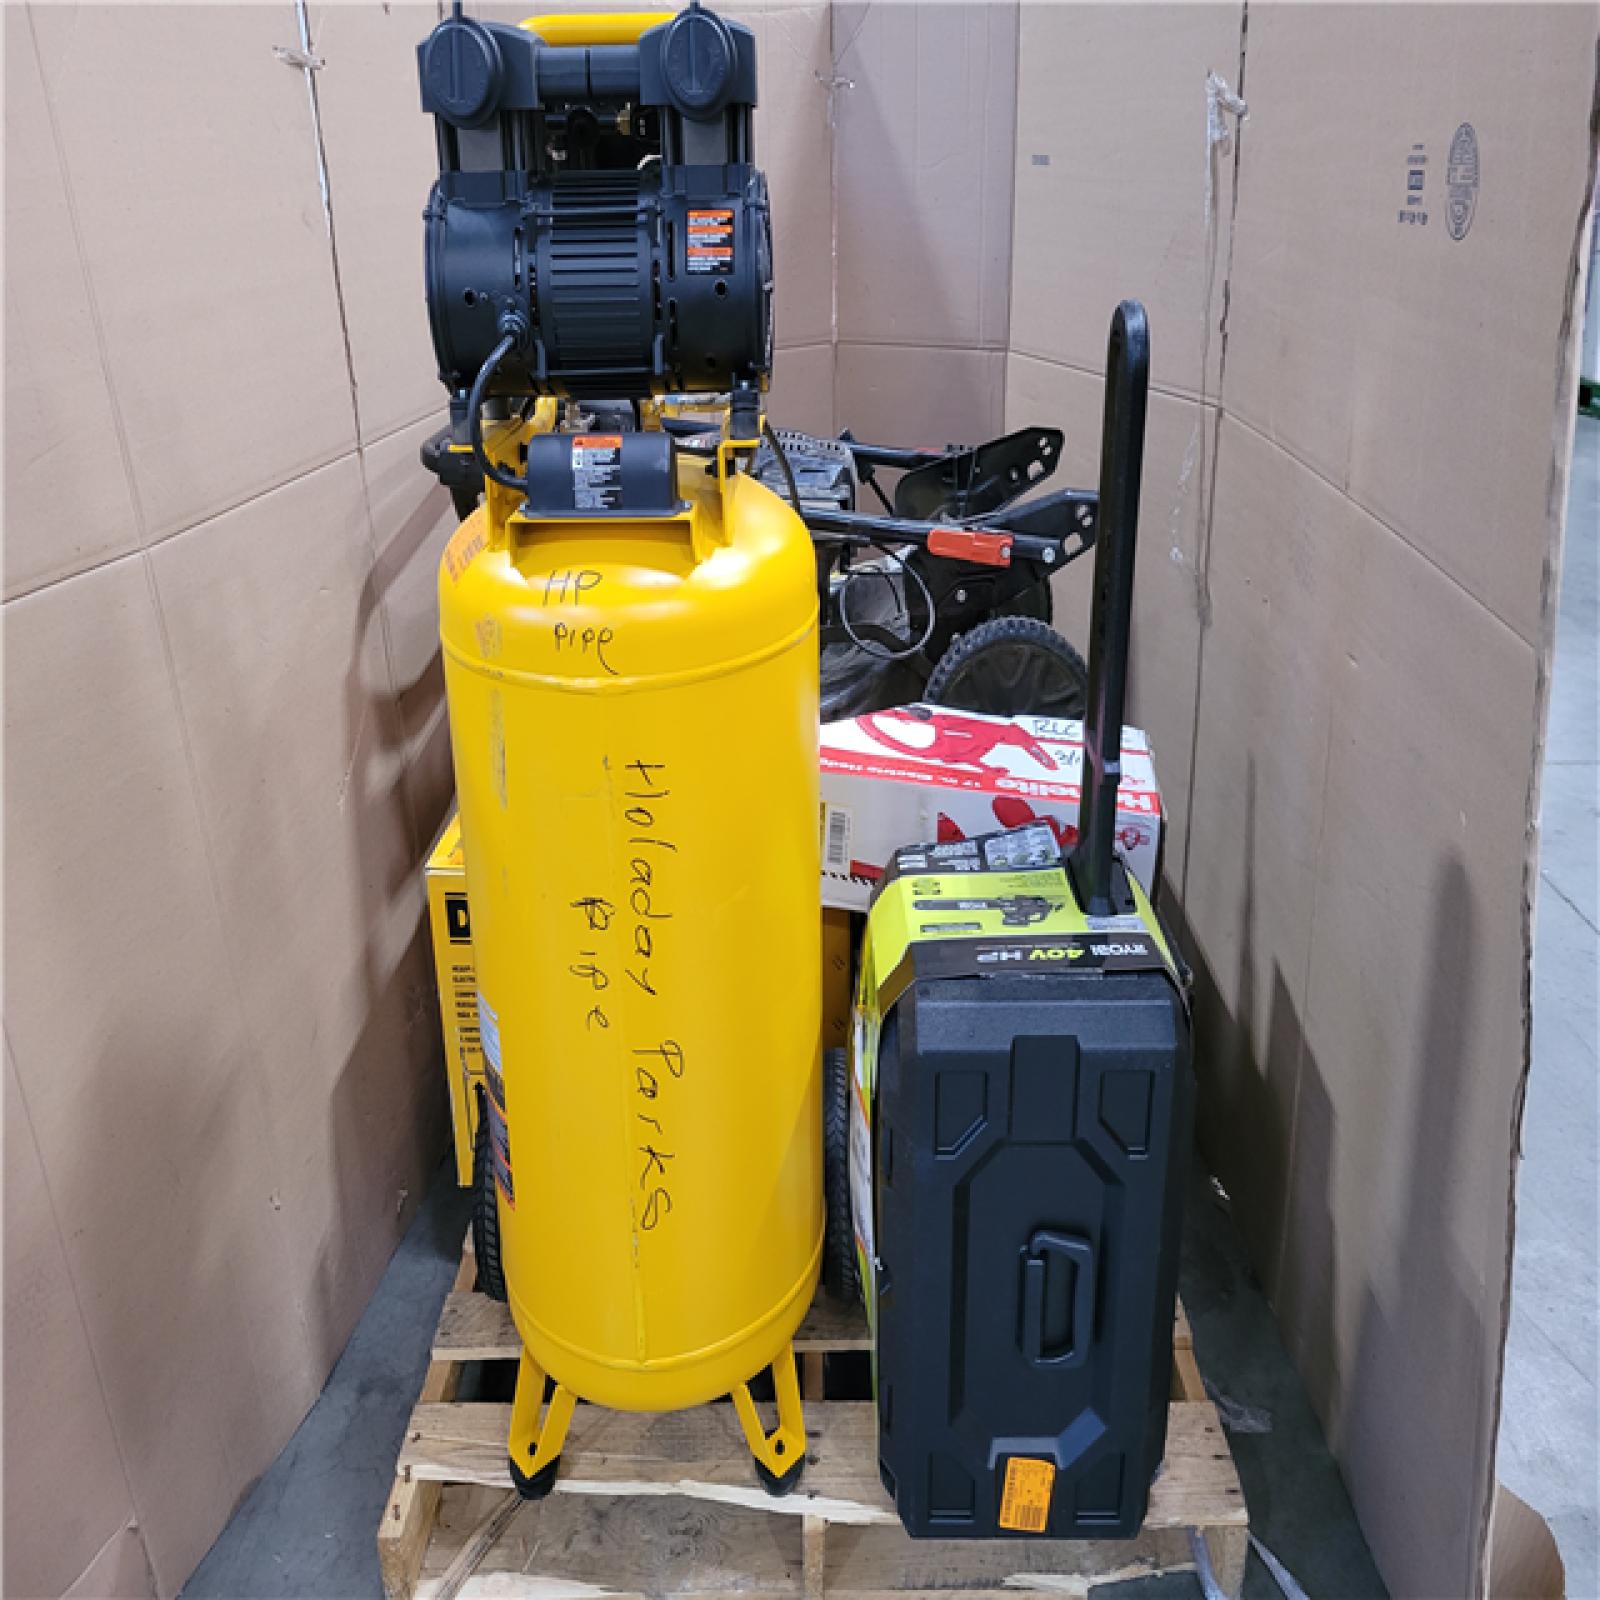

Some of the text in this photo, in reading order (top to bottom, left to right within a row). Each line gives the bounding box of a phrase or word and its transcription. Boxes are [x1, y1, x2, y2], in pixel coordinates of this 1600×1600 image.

[542, 569, 604, 608] HP
[976, 949, 1024, 964] HP
[1028, 947, 1086, 961] 40V
